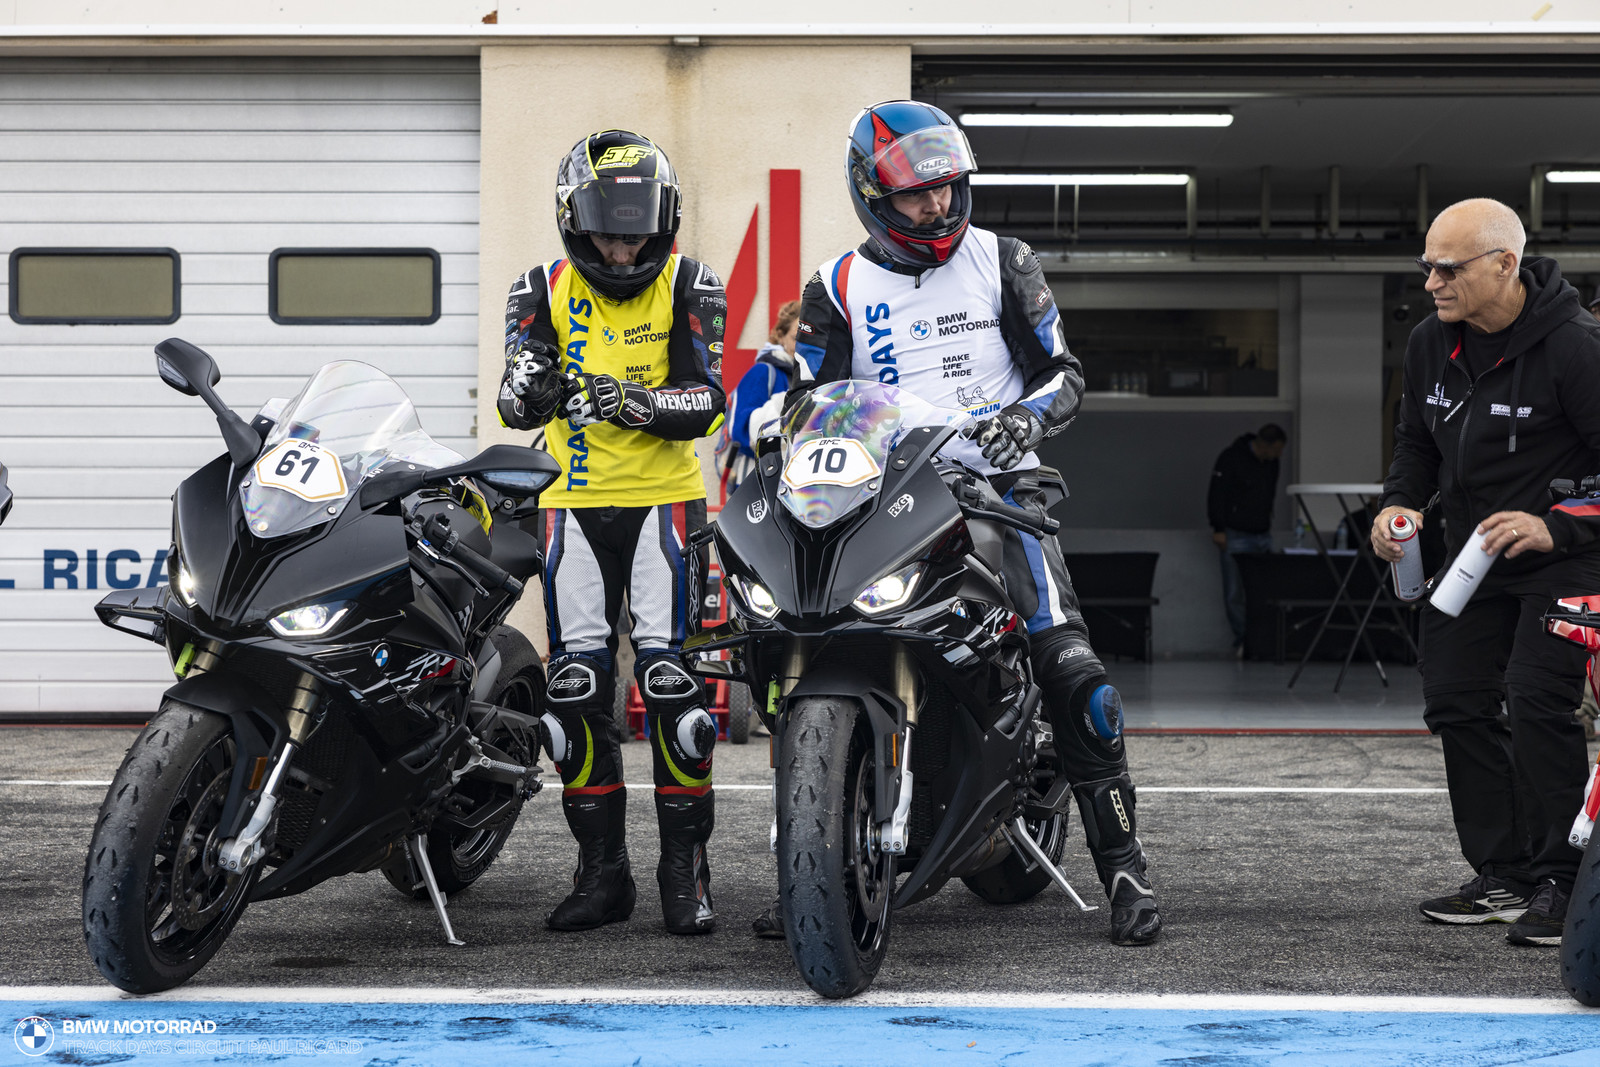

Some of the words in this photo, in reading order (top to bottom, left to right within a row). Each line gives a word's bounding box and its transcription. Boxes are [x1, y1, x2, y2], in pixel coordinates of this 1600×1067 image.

[921, 158, 946, 171] HJC
[617, 208, 640, 217] BELL
[936, 312, 968, 326] BMW
[624, 322, 652, 338] BMW
[938, 318, 1001, 337] MOTORRAD
[624, 331, 672, 345] MOTORR
[865, 302, 900, 386] DAYS
[942, 353, 971, 364] MAKE
[626, 364, 652, 374] MAKE
[942, 363, 963, 371] LIFE
[942, 371, 950, 379] A
[951, 369, 973, 378] RIDE
[626, 373, 645, 381] LIFE
[566, 418, 589, 492] TRAC
[807, 447, 848, 475] 10
[275, 449, 320, 485] 61
[43, 548, 172, 590] RICA
[1057, 647, 1093, 664] RST
[550, 677, 589, 691] RST
[649, 675, 688, 687] RST
